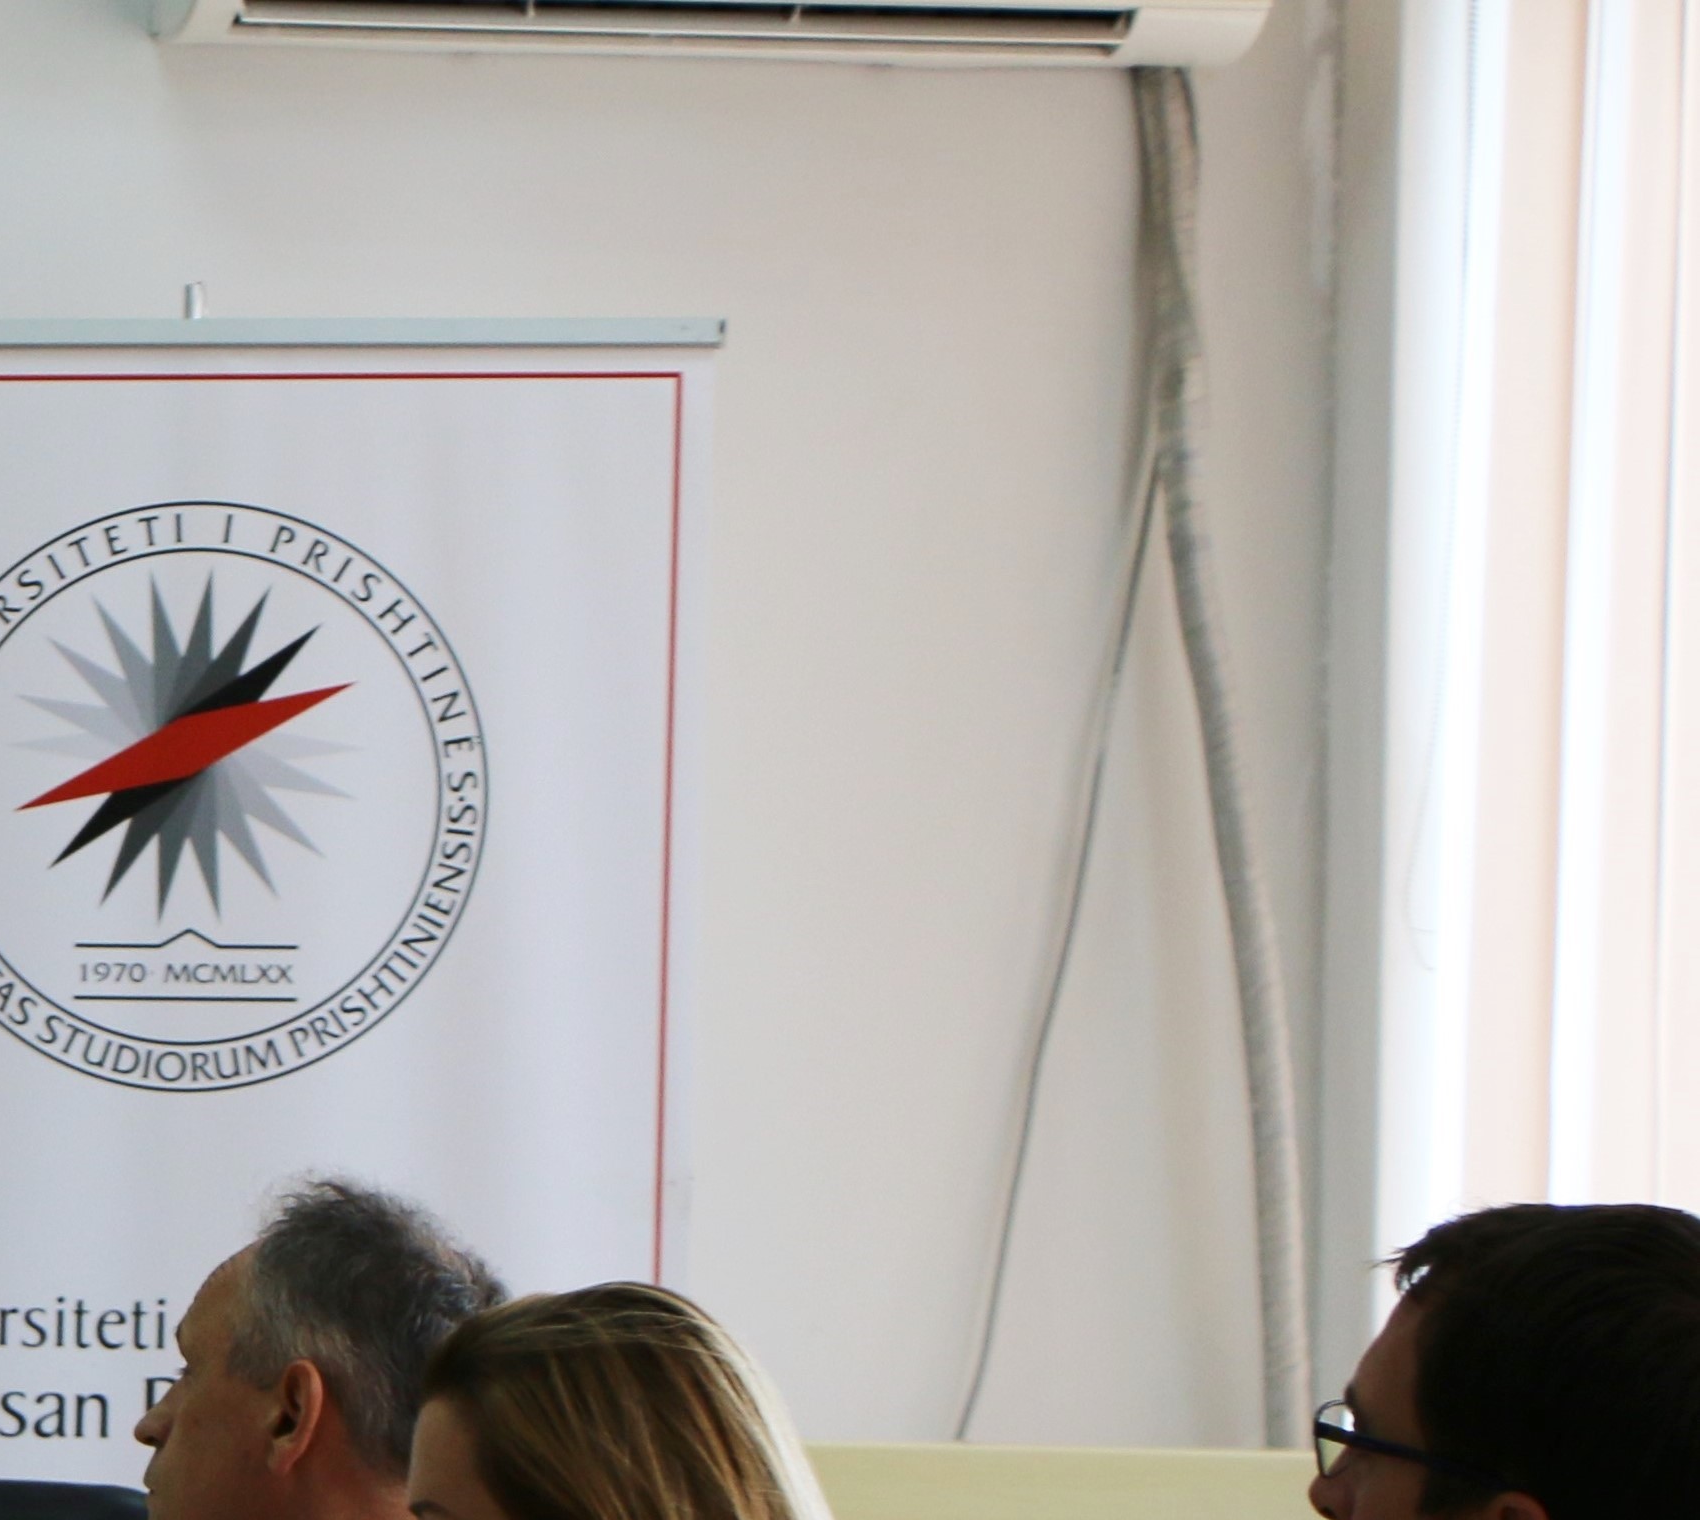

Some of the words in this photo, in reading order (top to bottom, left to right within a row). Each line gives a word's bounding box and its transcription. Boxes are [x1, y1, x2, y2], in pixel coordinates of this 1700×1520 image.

[78, 962, 147, 984] 1970
[163, 963, 295, 986] MCMLXX
[35, 1015, 283, 1083] STUDIORUM
